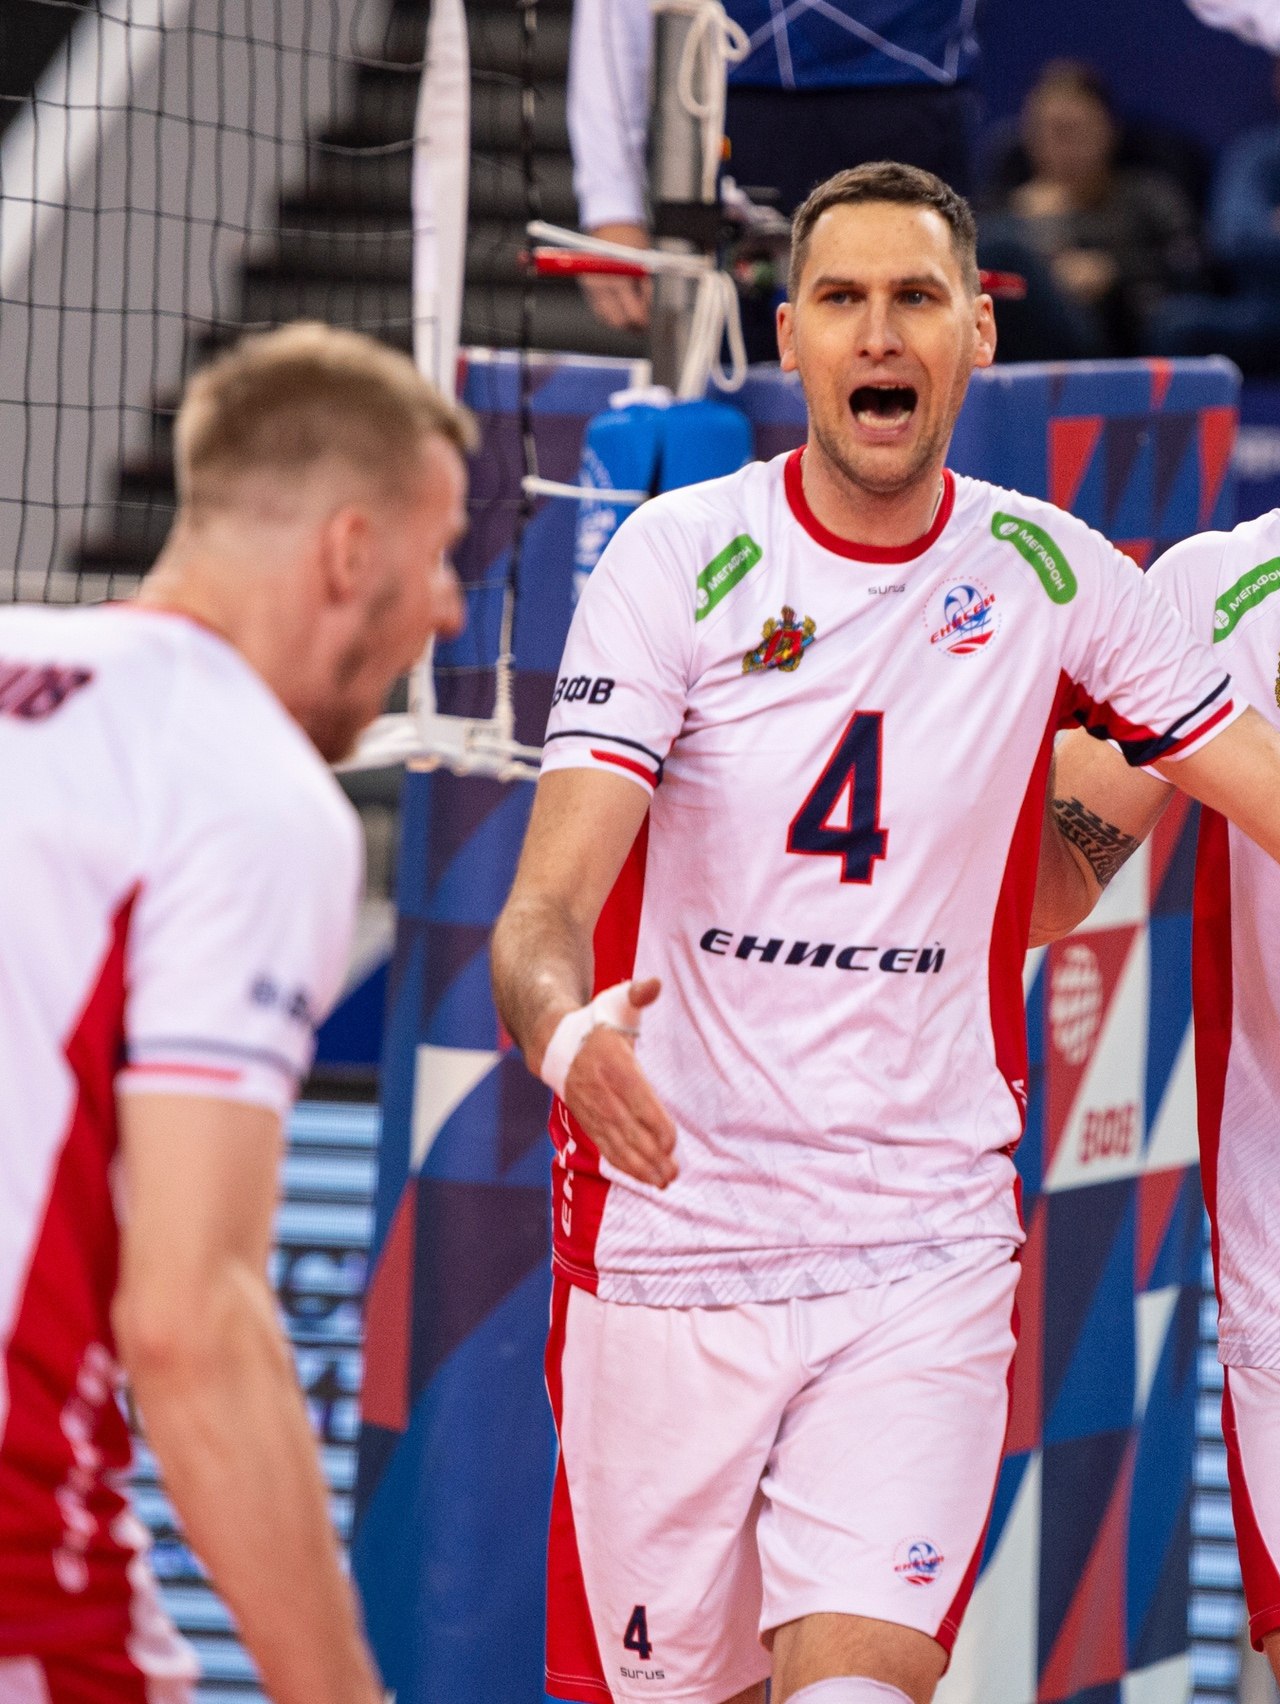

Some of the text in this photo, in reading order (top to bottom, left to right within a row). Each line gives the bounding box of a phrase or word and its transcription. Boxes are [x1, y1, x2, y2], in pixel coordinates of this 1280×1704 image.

[706, 546, 752, 591] МЕГАФОН
[1018, 529, 1067, 592] МЕГАФОН
[785, 710, 889, 885] 4
[700, 927, 946, 974] ЕНИСЕЙ
[623, 1604, 653, 1660] 4
